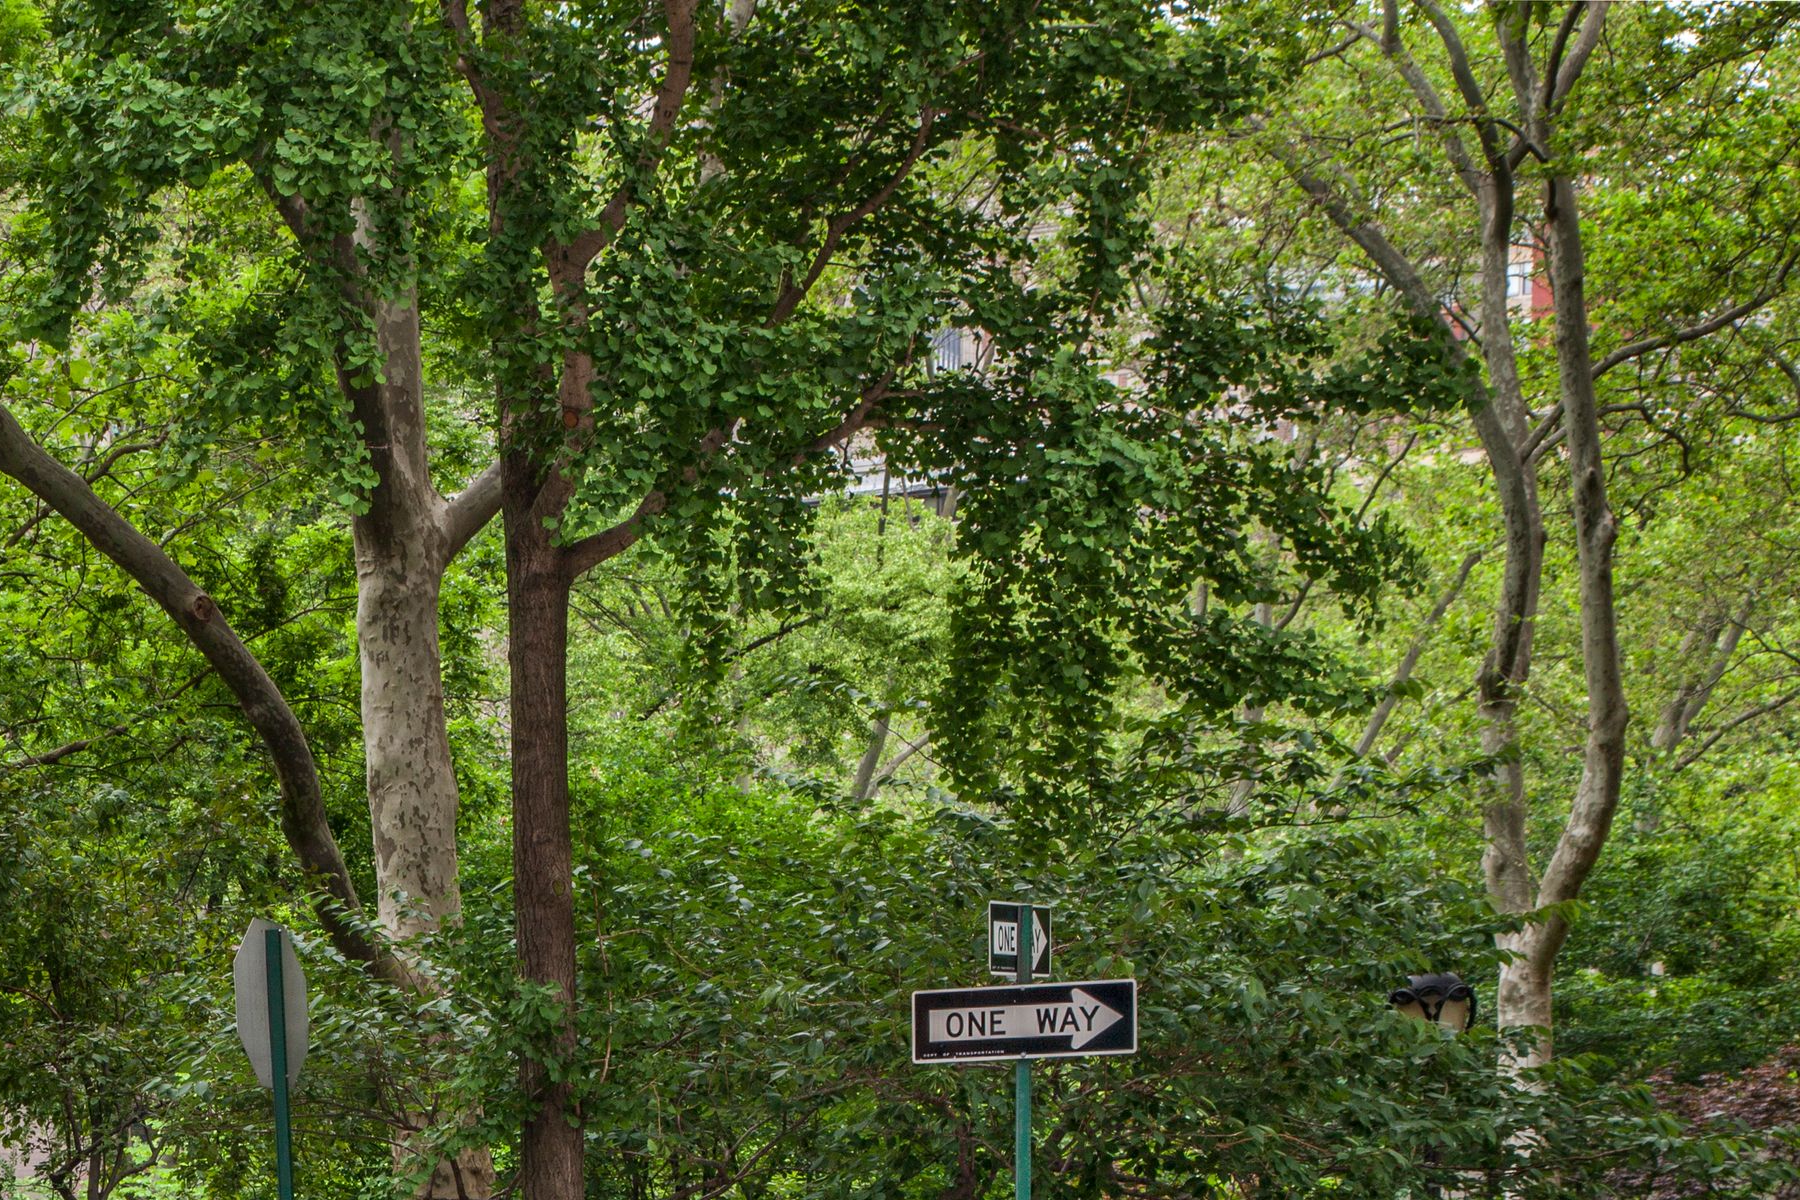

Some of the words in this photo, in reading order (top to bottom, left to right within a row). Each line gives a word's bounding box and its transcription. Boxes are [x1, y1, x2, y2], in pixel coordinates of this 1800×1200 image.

[998, 925, 1015, 951] ONE
[946, 1010, 1006, 1037] ONE
[1036, 1005, 1100, 1034] WAY
